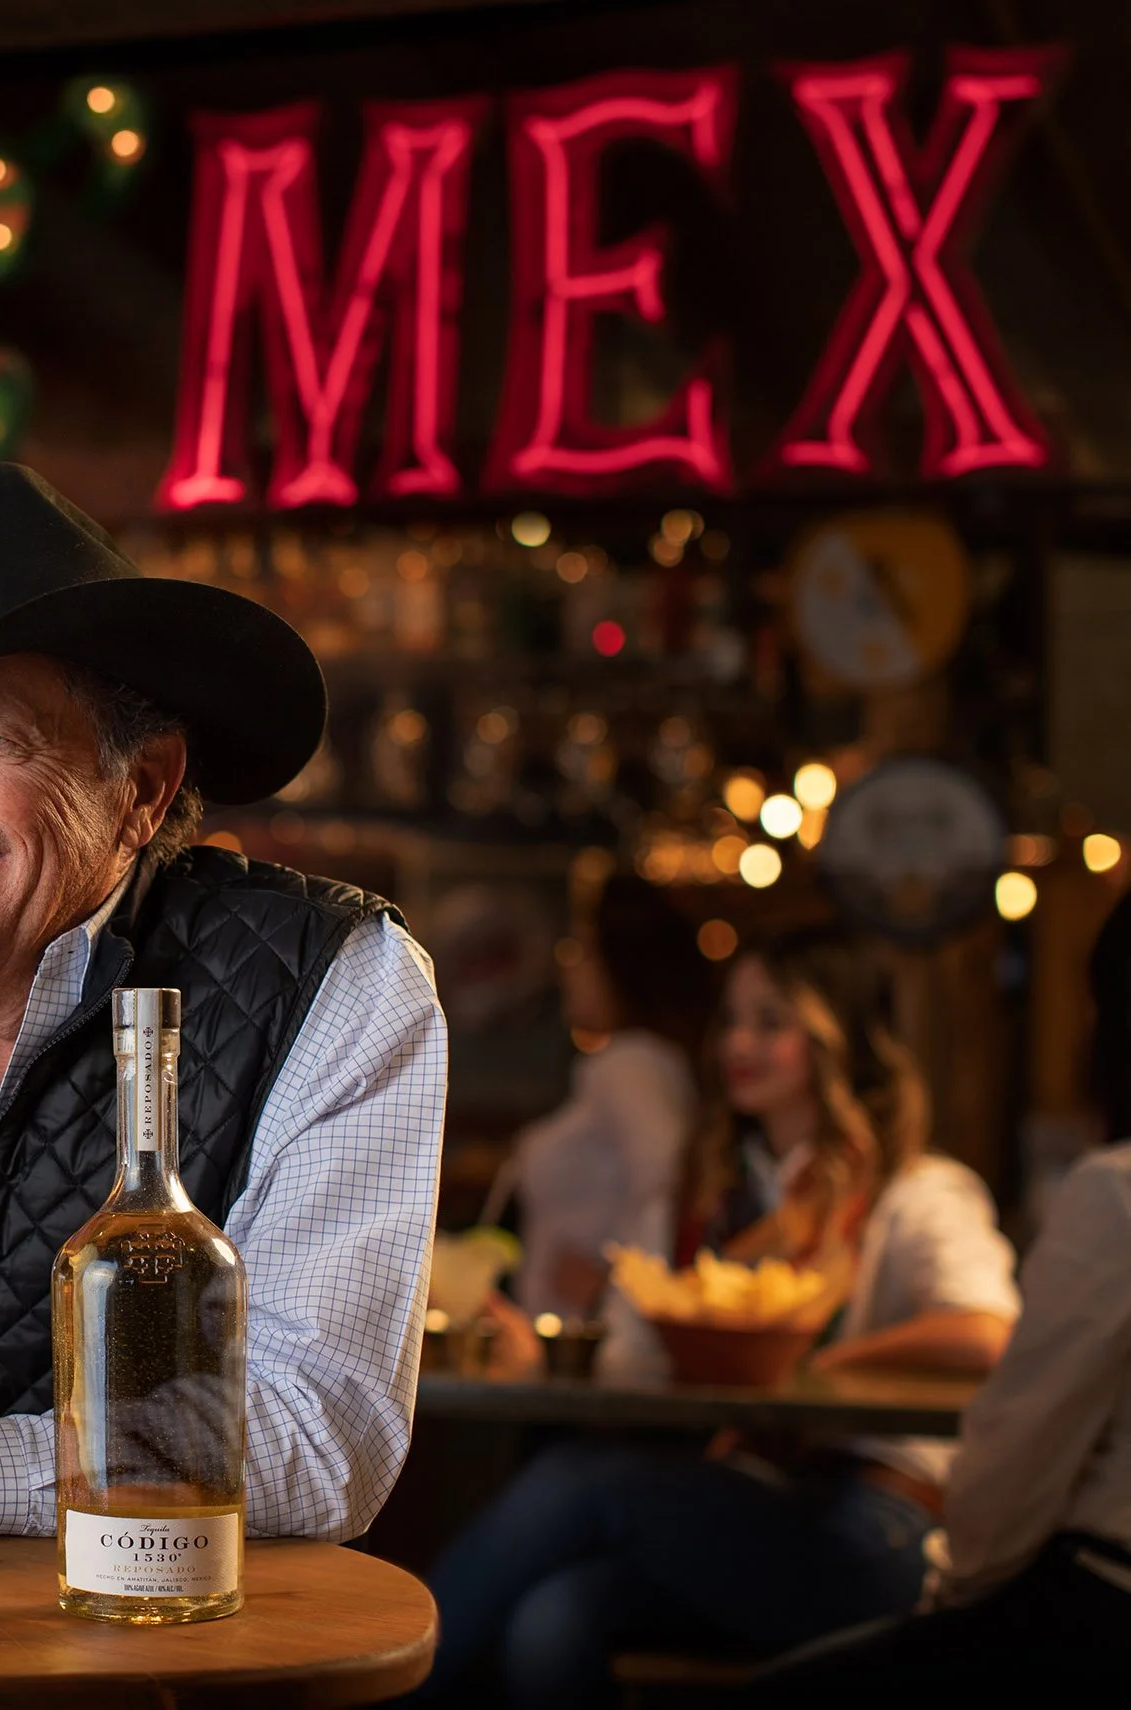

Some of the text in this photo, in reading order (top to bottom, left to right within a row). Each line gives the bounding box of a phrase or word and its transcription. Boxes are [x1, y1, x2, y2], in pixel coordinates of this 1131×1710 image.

[157, 46, 1069, 515] MEX
[144, 1041, 153, 1124] REPOSADO
[139, 1524, 170, 1536] Tequila
[100, 1531, 209, 1550] CÓDIGO
[113, 1564, 196, 1574] REPOSADO
